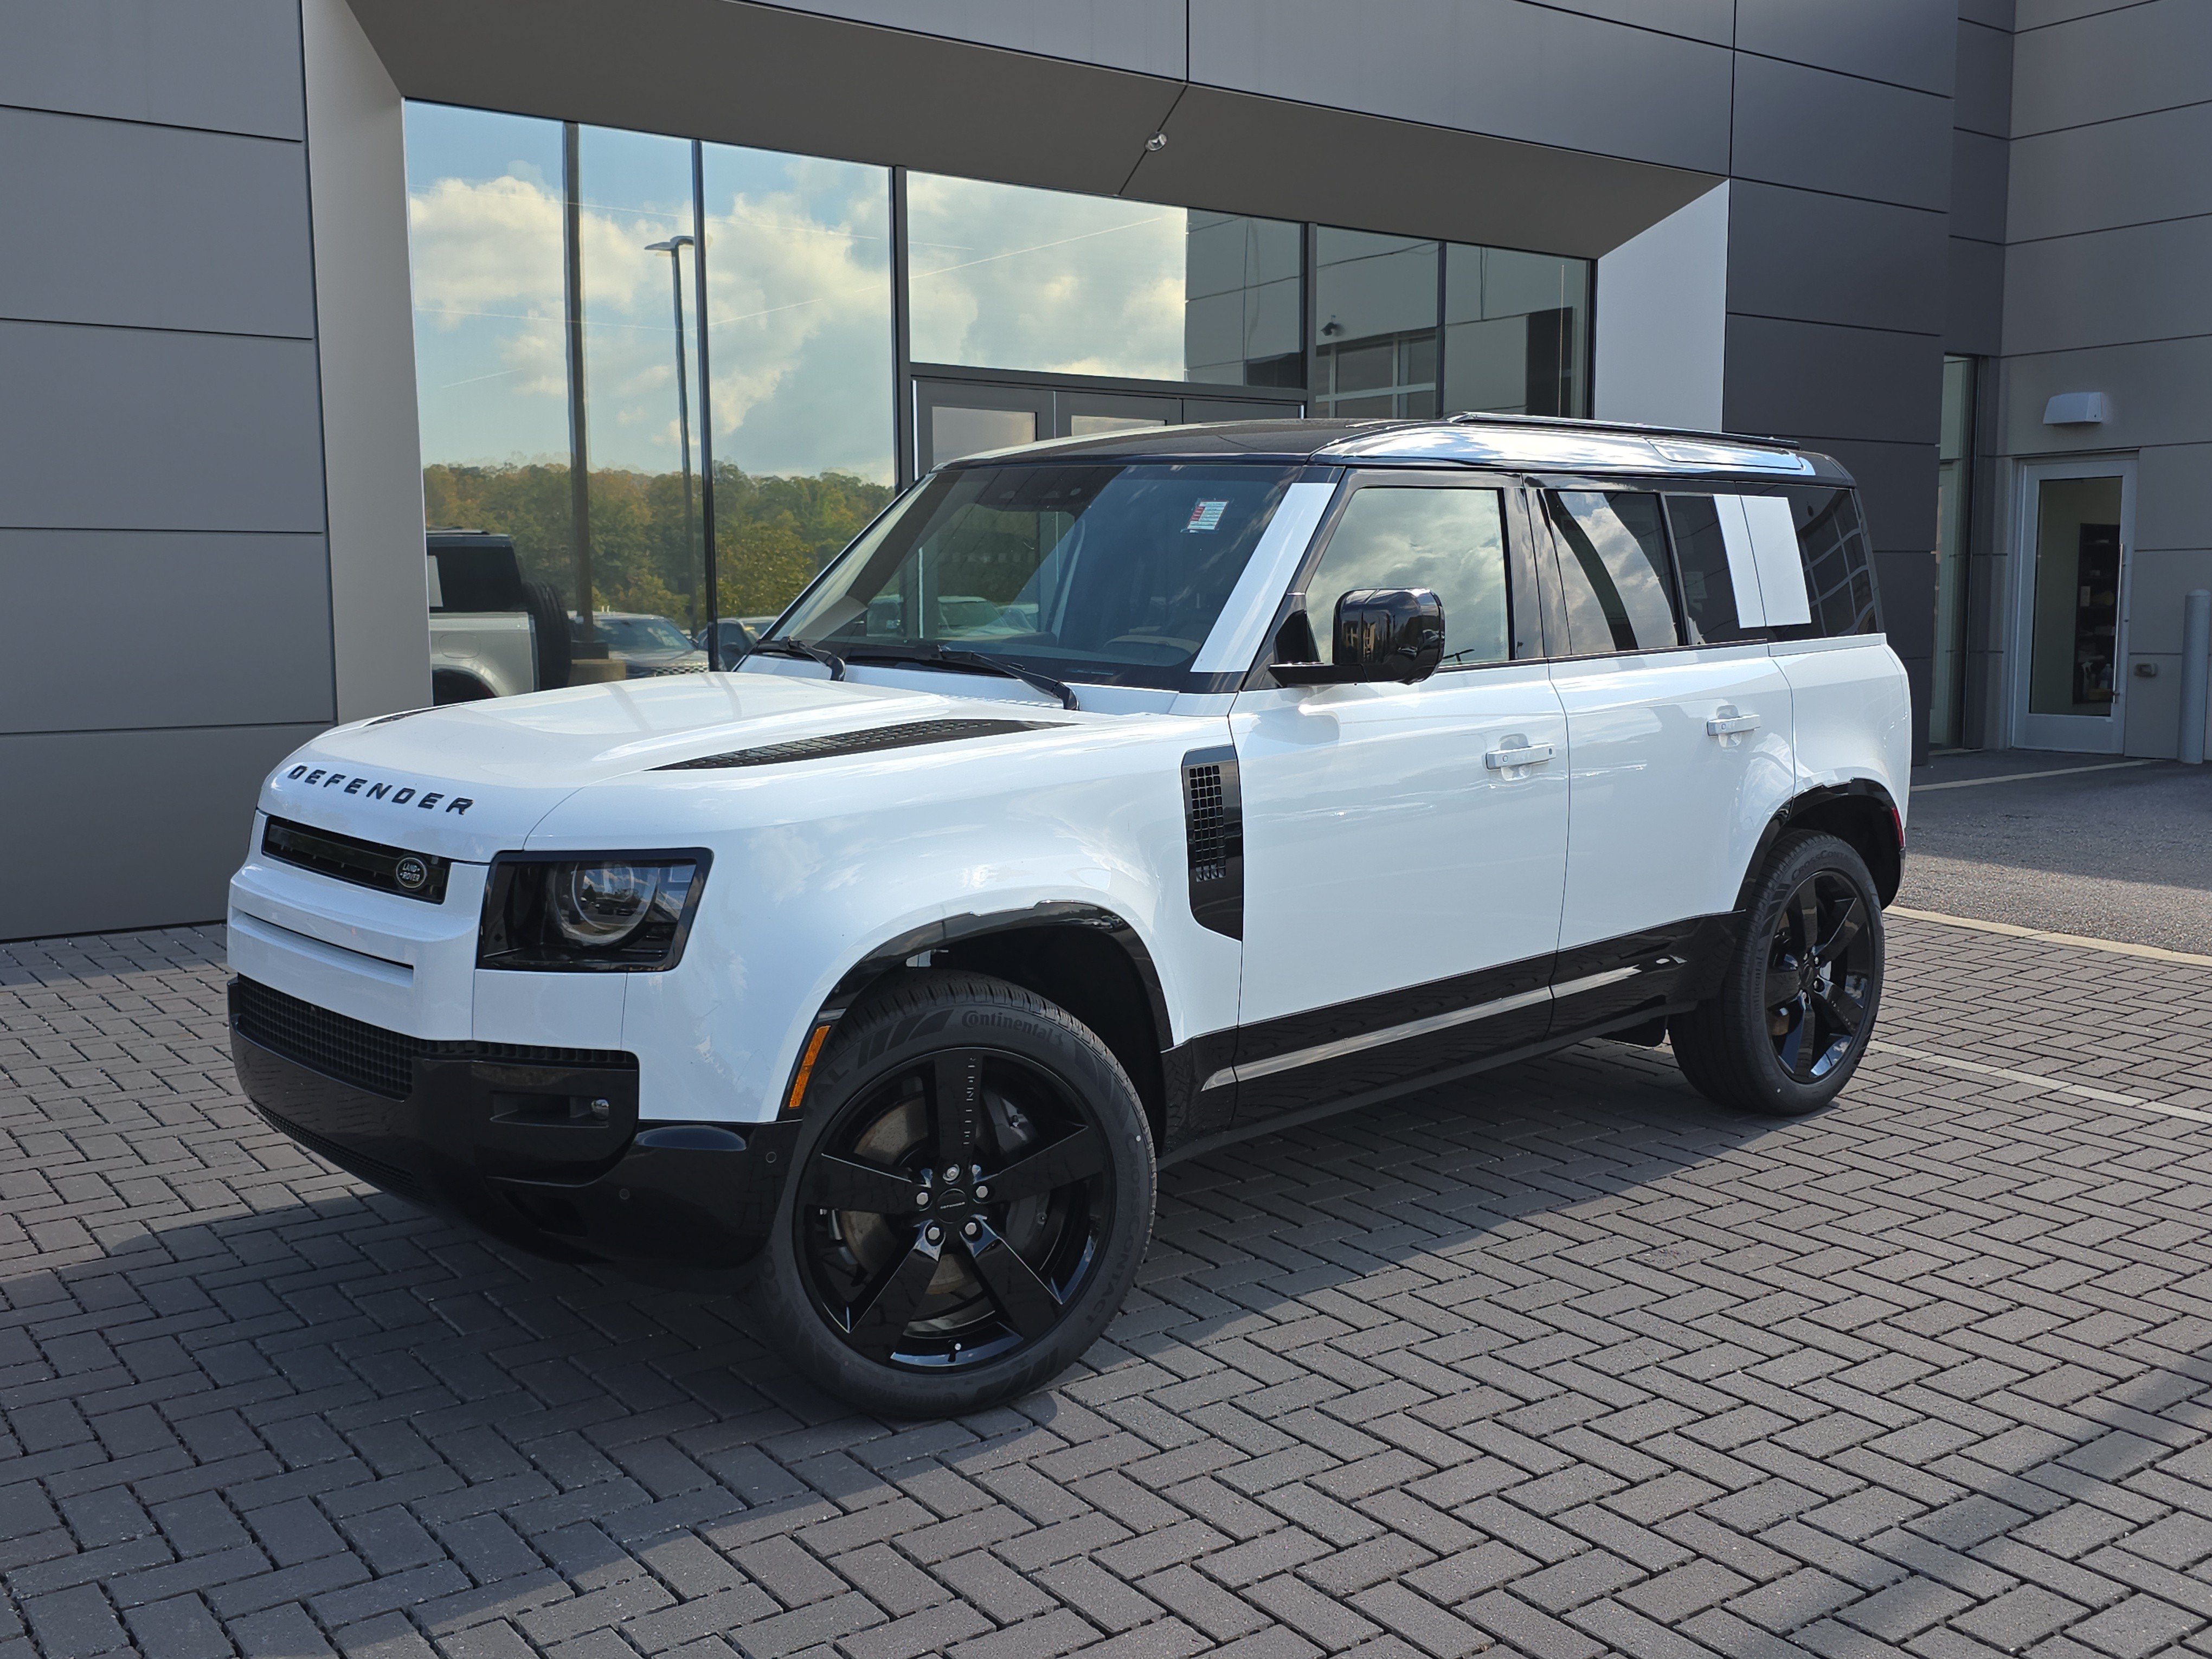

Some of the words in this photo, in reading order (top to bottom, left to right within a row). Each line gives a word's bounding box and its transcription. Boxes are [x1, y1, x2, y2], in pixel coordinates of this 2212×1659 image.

[287, 765, 474, 815] DEFENDER
[402, 863, 417, 872] LAND
[402, 871, 420, 882] ROVER
[963, 1010, 1054, 1040] Continental
